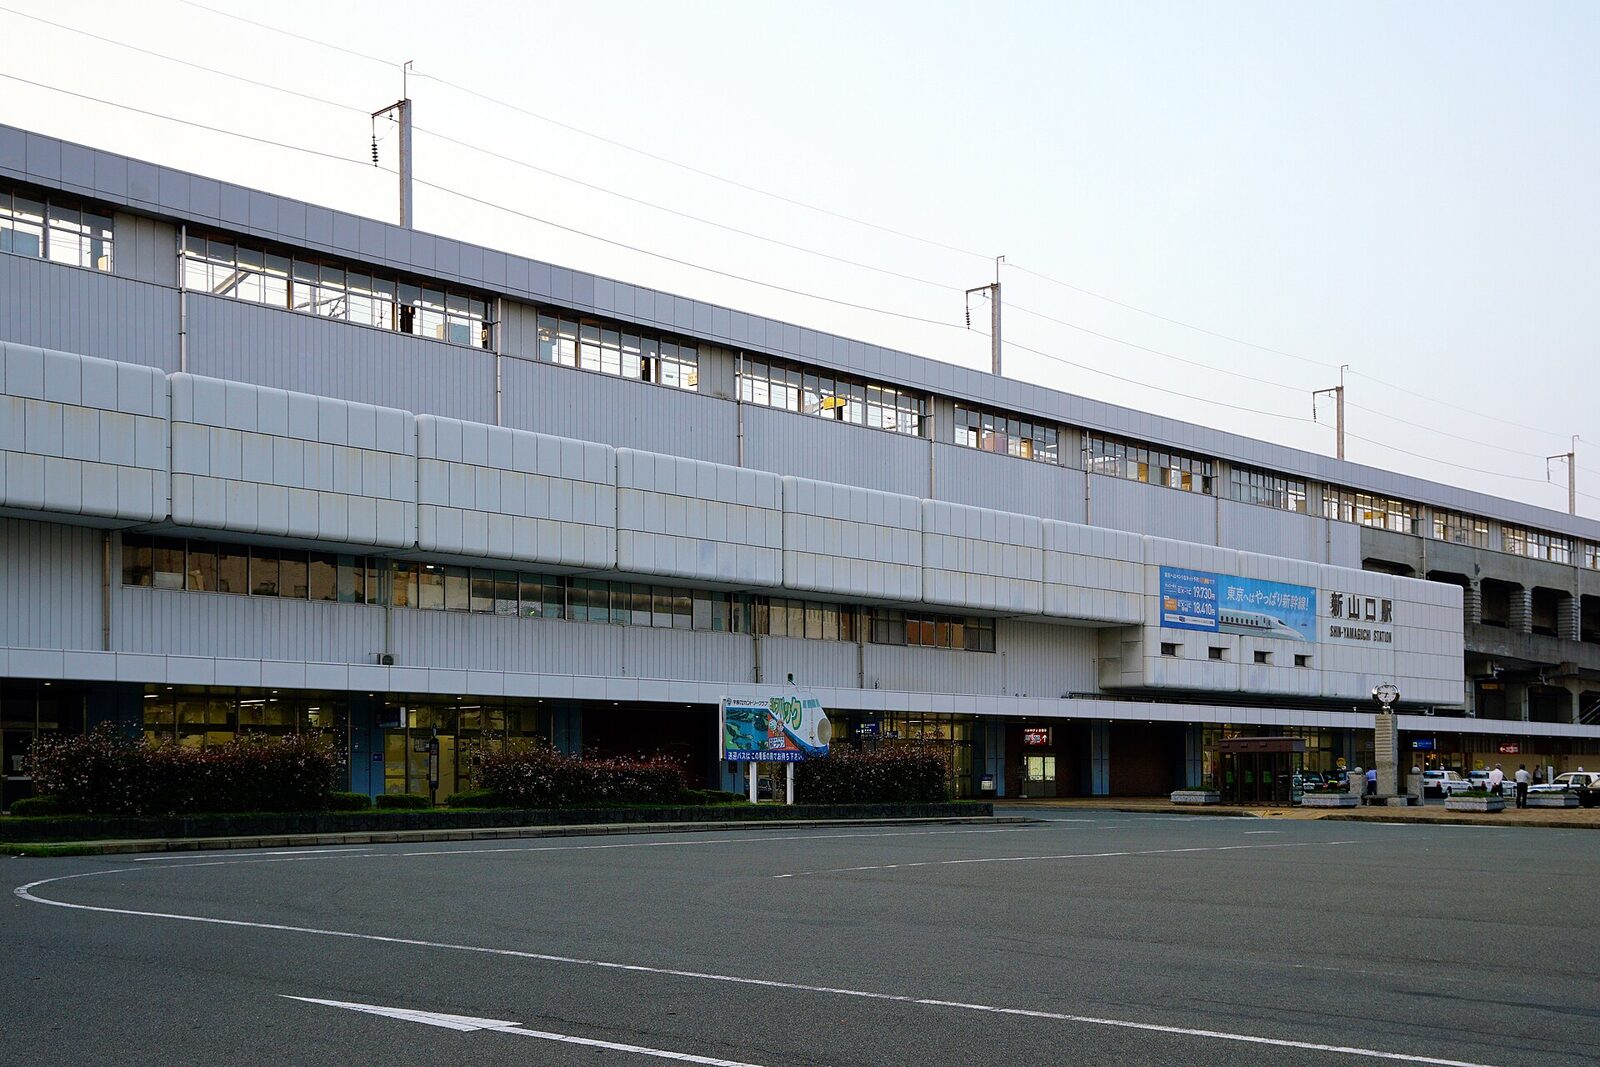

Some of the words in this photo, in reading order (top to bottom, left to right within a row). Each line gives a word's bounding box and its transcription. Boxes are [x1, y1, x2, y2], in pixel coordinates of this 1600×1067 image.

[1226, 586, 1309, 611] 東京へはやっぱり新幹線!
[1331, 592, 1392, 622] 新山口駅
[1330, 625, 1371, 641] SHIN-YAMAGUCHI
[1373, 630, 1392, 643] STATION
